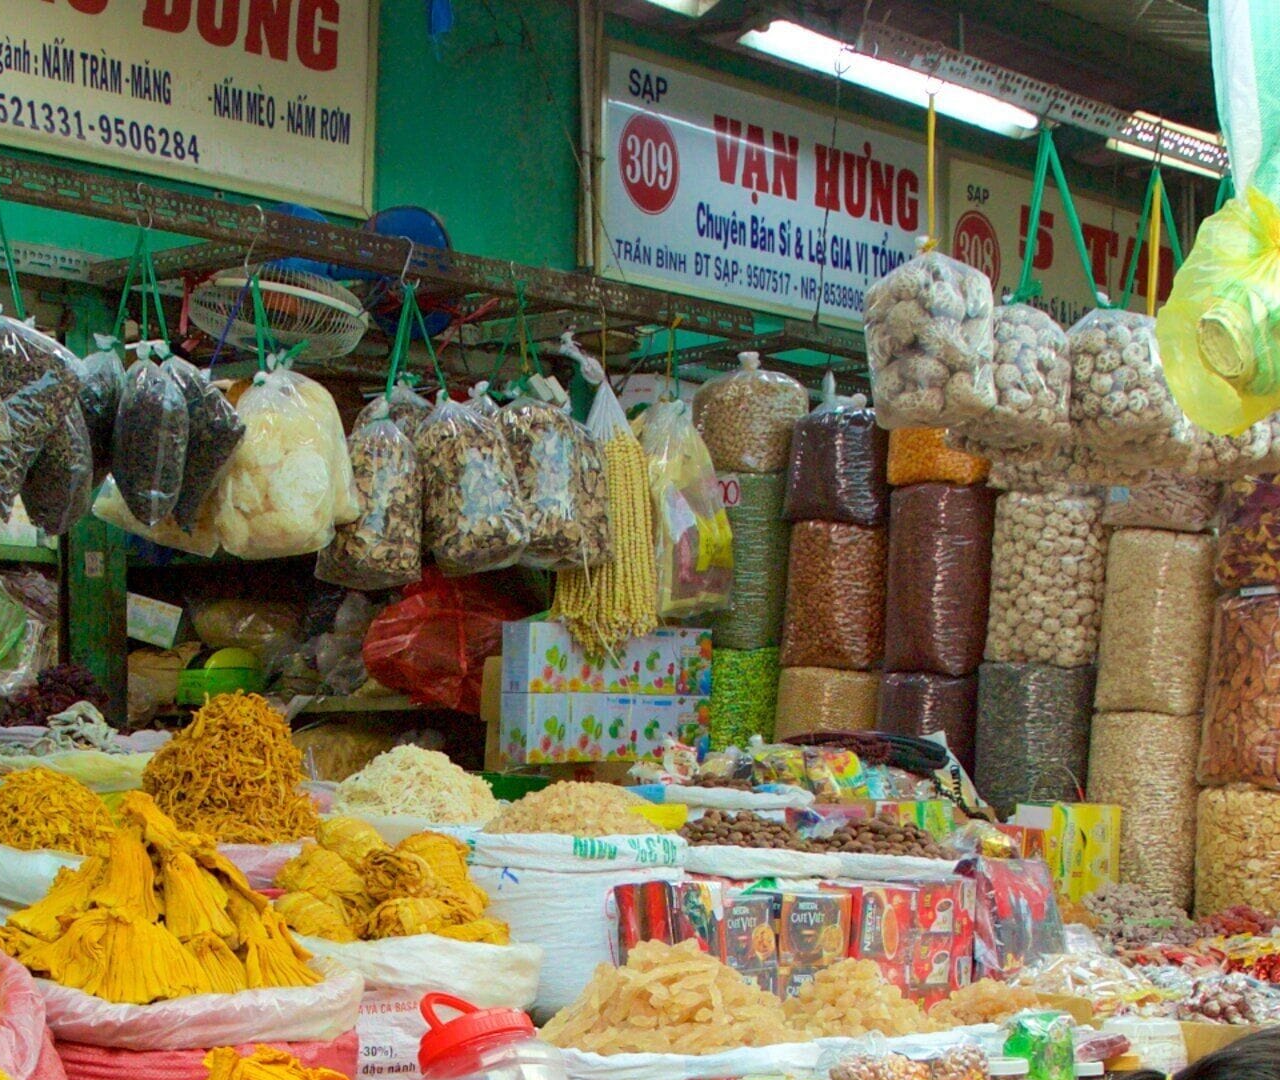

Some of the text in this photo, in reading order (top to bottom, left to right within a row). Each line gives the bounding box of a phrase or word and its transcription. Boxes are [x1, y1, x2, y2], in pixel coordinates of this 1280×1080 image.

[42, 37, 74, 83] NẤM
[81, 49, 121, 94] TRÀM
[247, 85, 275, 129] MÈO
[321, 106, 351, 145] RƠM
[628, 68, 668, 104] SẠP
[626, 134, 673, 191] 309
[713, 114, 919, 232] VẠN HƯNG
[656, 243, 687, 274] BÌNH
[694, 252, 711, 277] ĐT
[746, 264, 791, 296] 9507517
[696, 201, 746, 249] Chuyên
[750, 214, 775, 253] Bán
[779, 219, 791, 258] Sỉ
[795, 229, 804, 260] &
[831, 235, 852, 272] GIA
[856, 241, 869, 286] VỊ
[959, 230, 995, 281] 308
